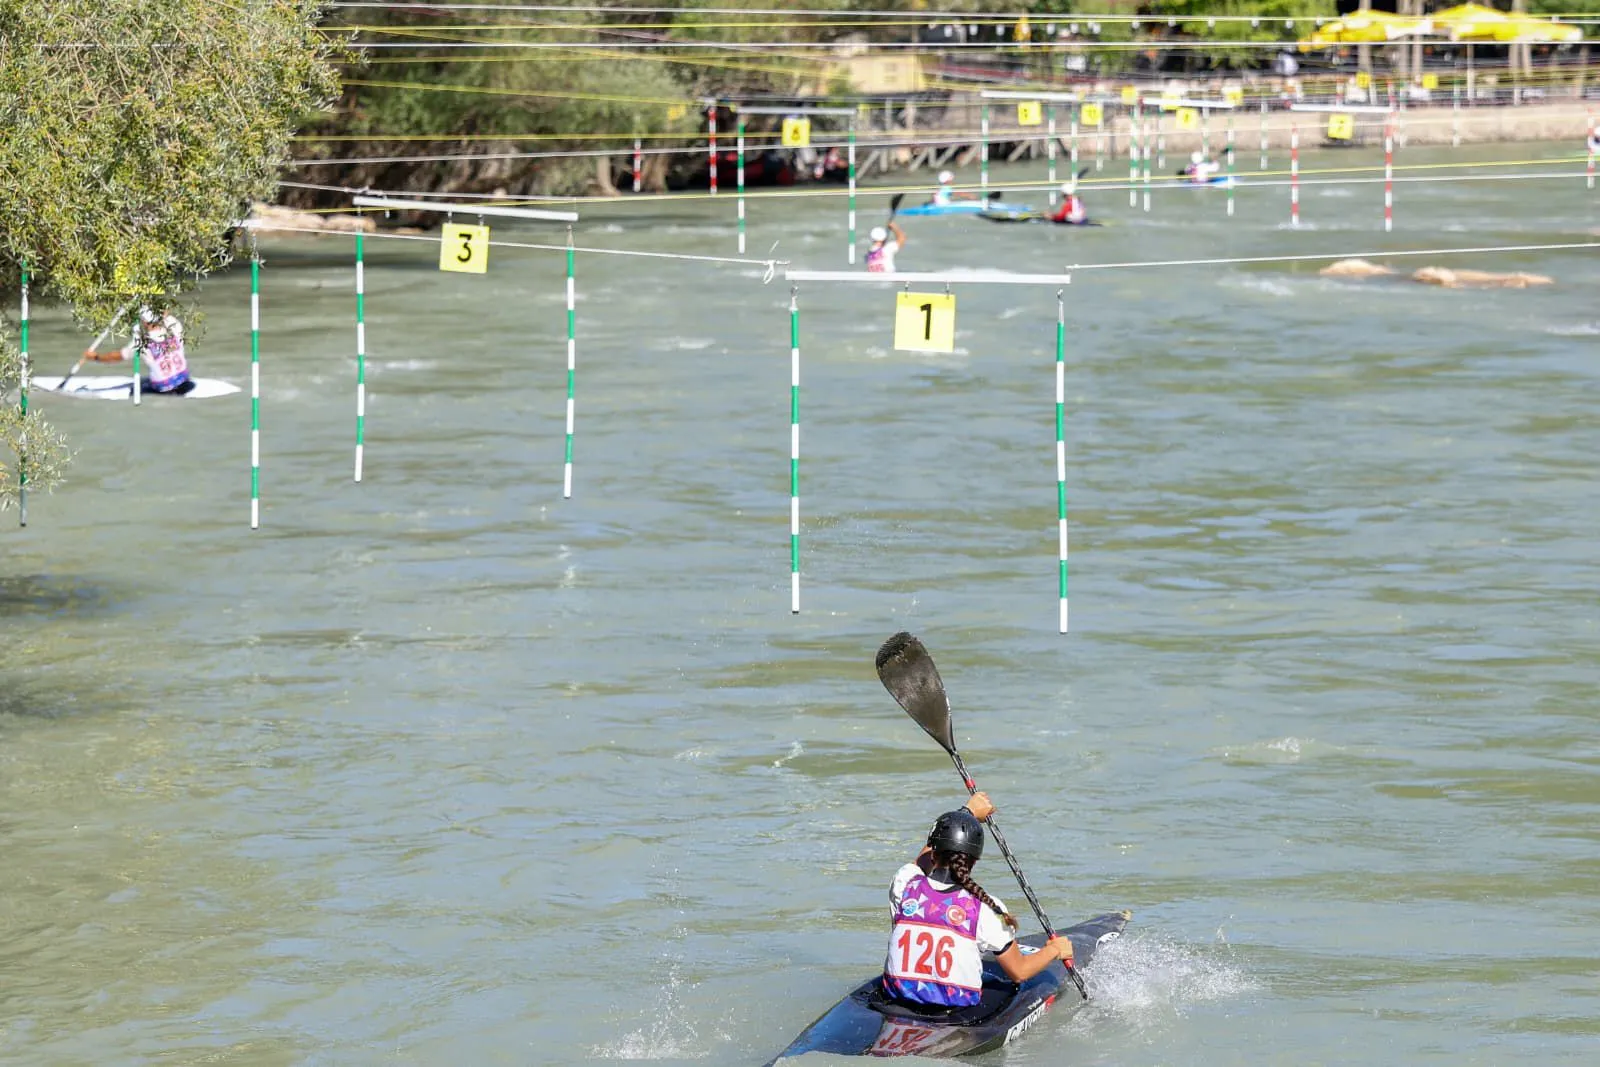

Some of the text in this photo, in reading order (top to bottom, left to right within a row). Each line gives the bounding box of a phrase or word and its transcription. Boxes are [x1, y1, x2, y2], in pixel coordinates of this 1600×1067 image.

[457, 233, 472, 263] 3
[920, 303, 932, 340] 1
[898, 929, 955, 978] 126
